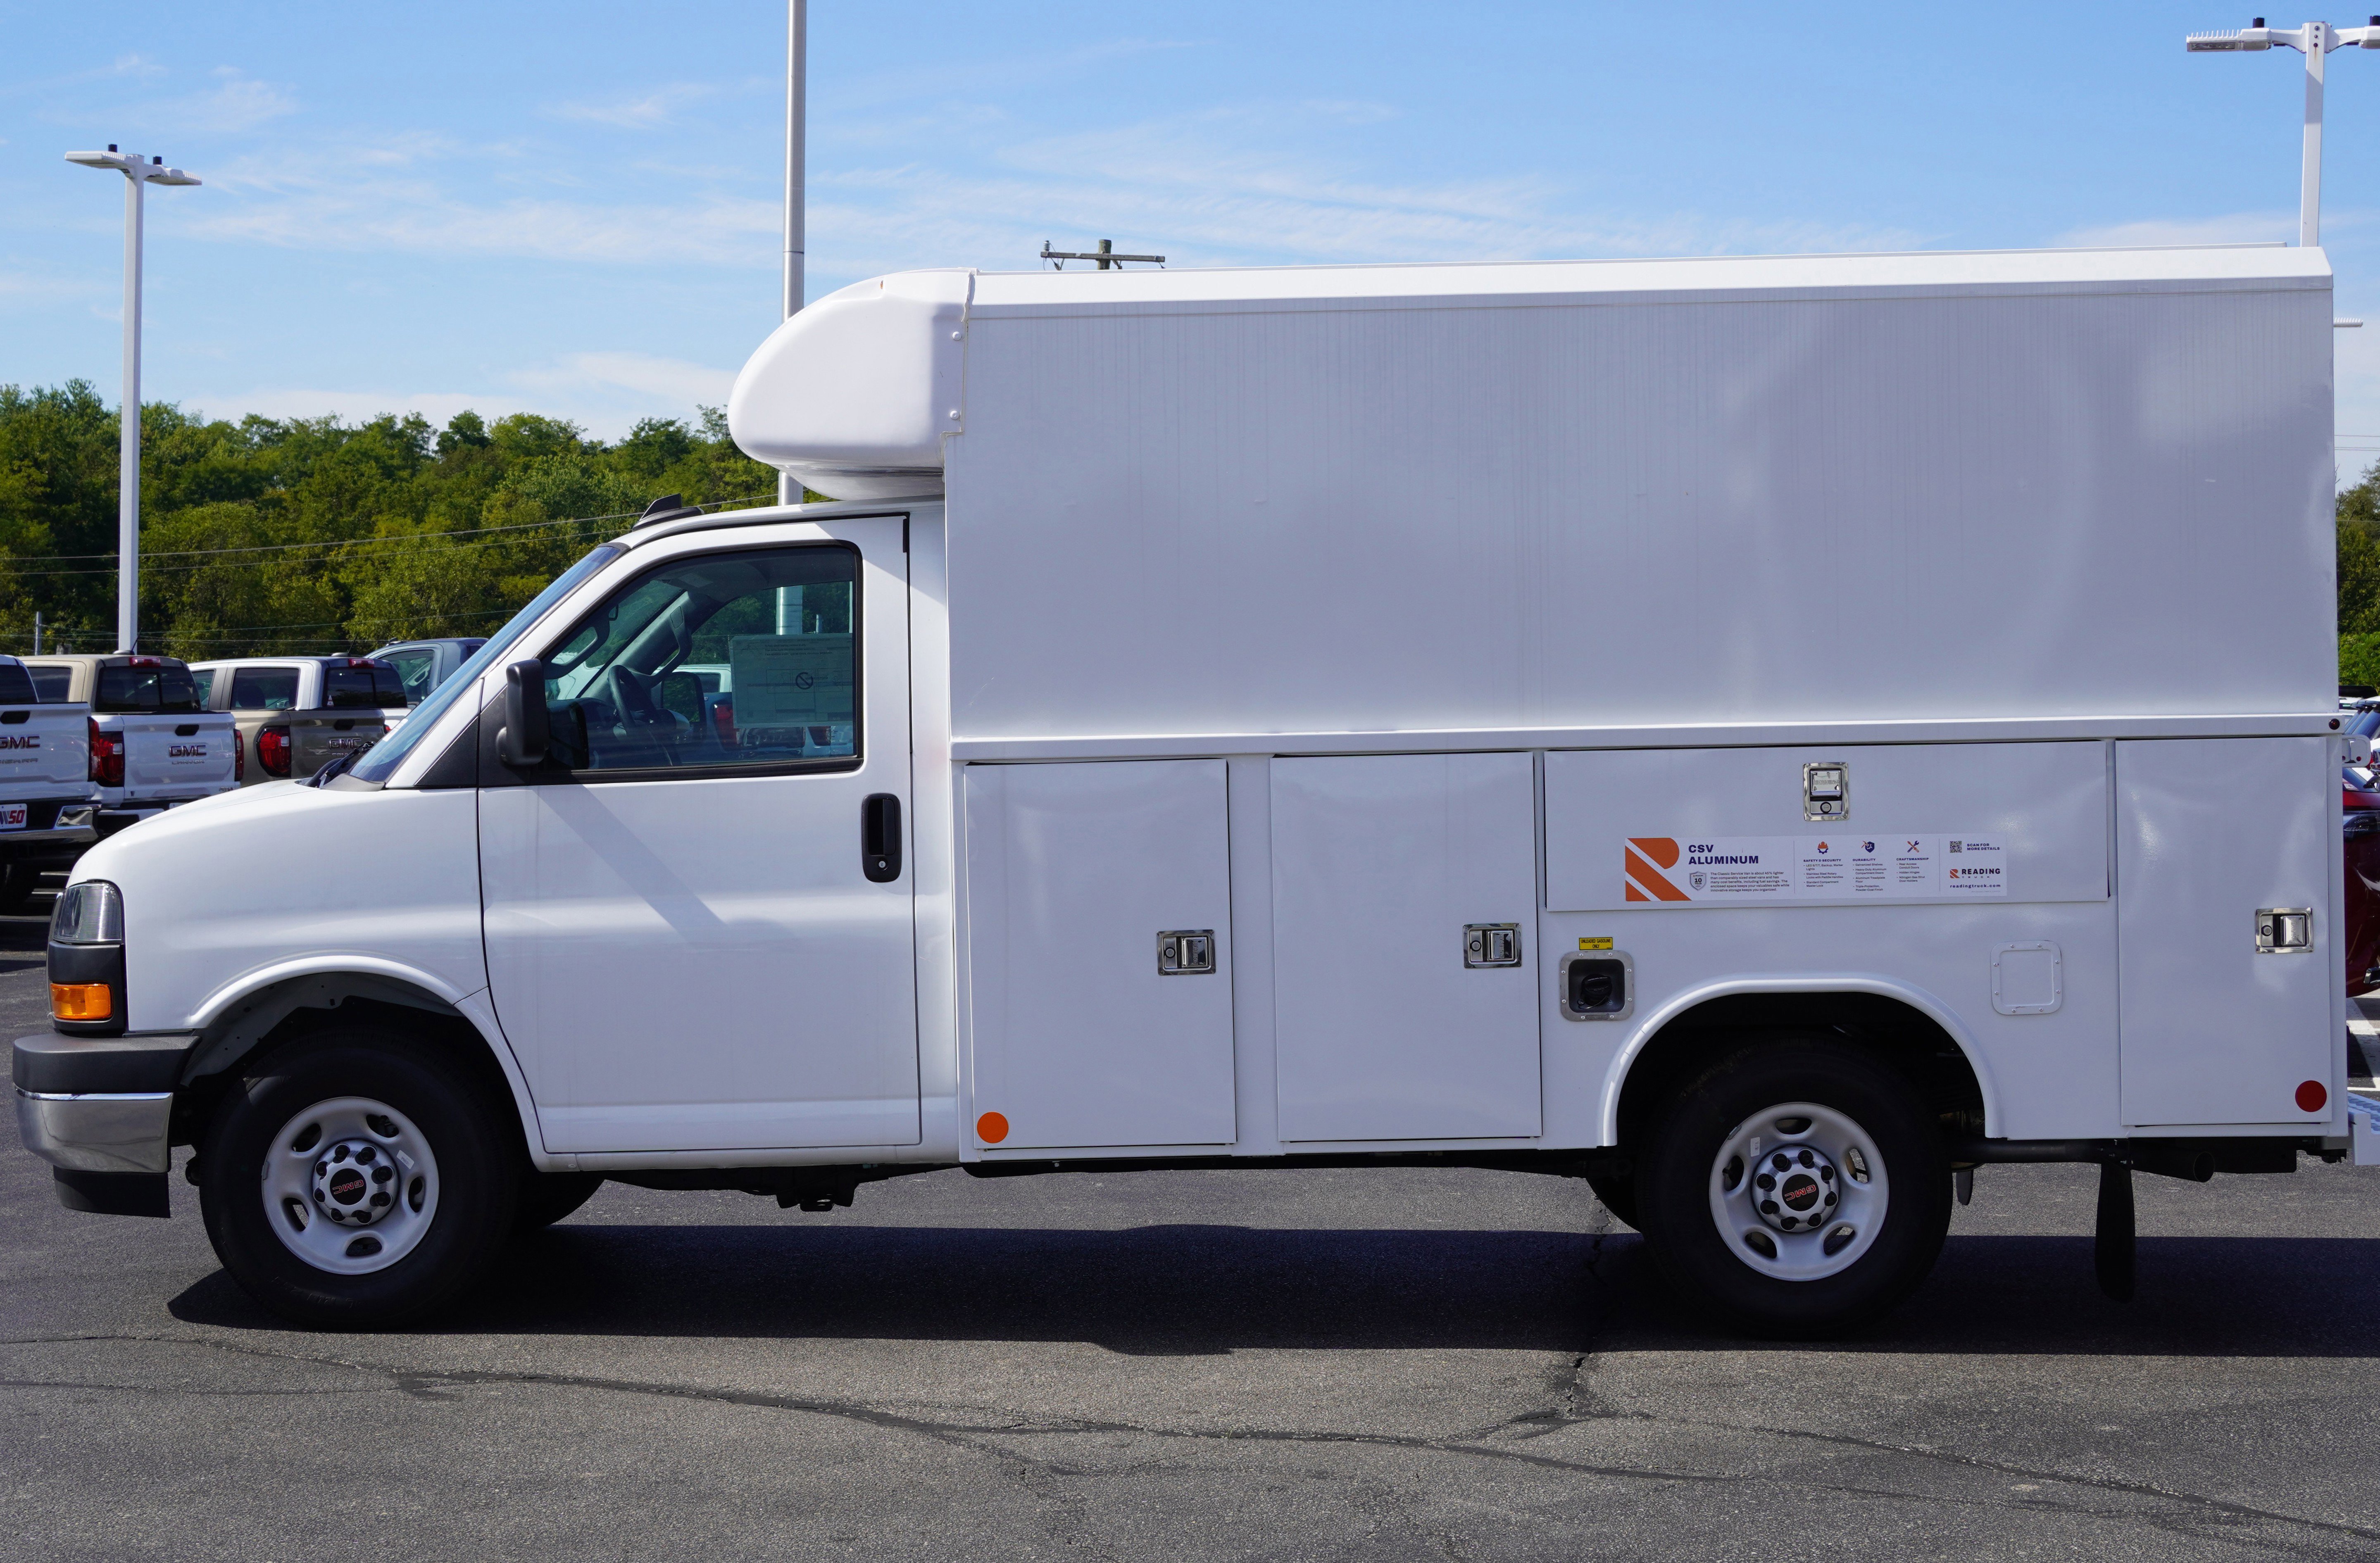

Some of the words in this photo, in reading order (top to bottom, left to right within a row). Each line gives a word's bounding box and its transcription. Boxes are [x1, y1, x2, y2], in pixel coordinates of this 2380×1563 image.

[0, 735, 40, 749] GMC
[329, 738, 362, 750] GMC
[169, 745, 207, 757] GMC
[1688, 845, 1714, 853] CSV
[1688, 856, 1759, 865] ALUMINUM
[332, 1180, 364, 1194] GMC
[1785, 1184, 1816, 1201] GMC
